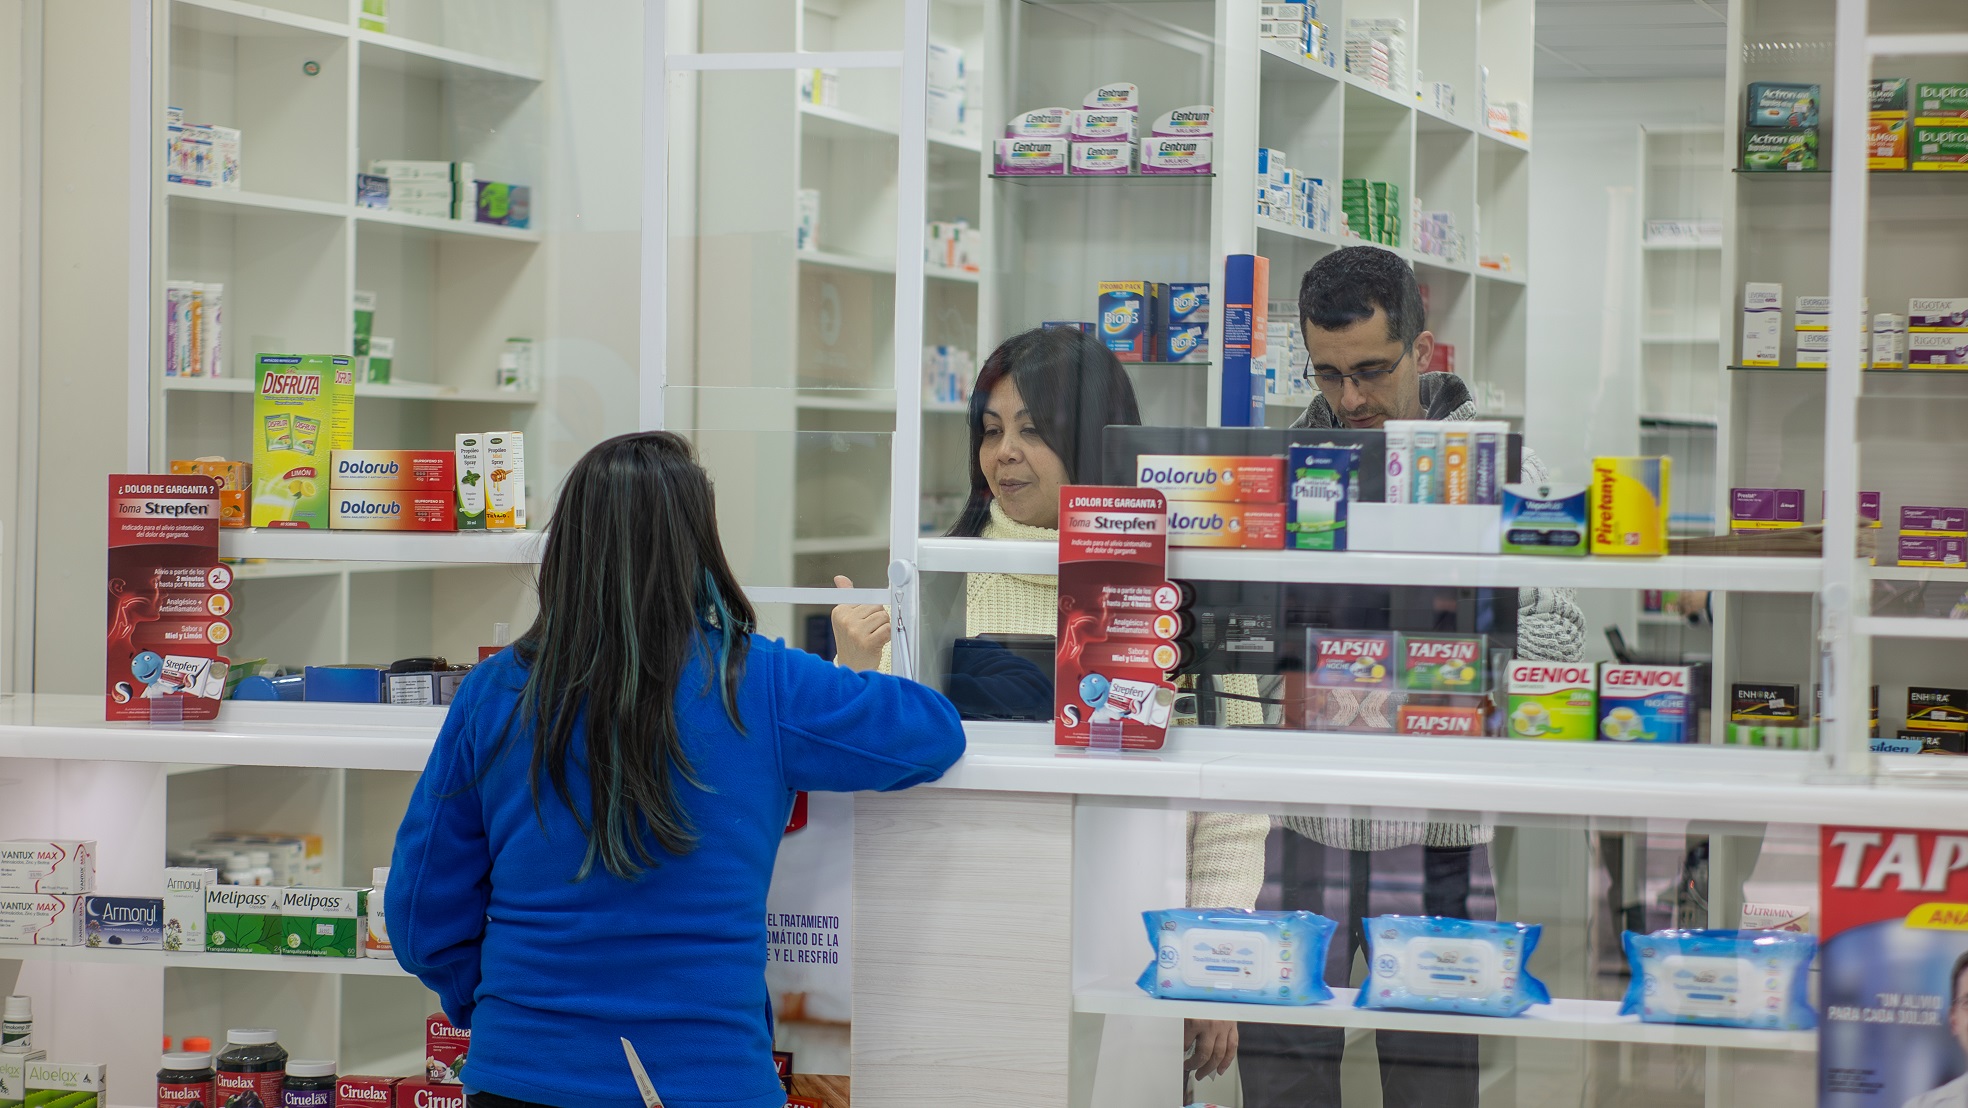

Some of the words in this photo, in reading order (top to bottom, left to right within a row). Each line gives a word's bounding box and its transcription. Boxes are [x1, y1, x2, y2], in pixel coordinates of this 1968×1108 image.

[1098, 89, 1130, 97] Centrum
[1762, 89, 1796, 99] Actron
[1026, 114, 1062, 123] Centrum
[1086, 115, 1118, 123] Centrum
[1171, 111, 1210, 121] Centrum
[1748, 134, 1788, 144] Actron
[1012, 142, 1052, 151] Centrum
[1160, 142, 1197, 151] Centrum
[1913, 301, 1951, 309] RIGOTAX
[1914, 336, 1952, 345] RIGOTAX
[262, 373, 320, 395] DISFRUTA
[291, 468, 311, 477] LIMÓN
[339, 461, 399, 474] Dolorub
[1141, 468, 1217, 484] Dolorub
[125, 485, 152, 494] DOLOR
[153, 485, 164, 494] DE
[166, 485, 208, 494] GARGANTA
[210, 486, 214, 494] ?
[1295, 485, 1340, 501] Phillips
[119, 504, 141, 513] Toma
[145, 502, 208, 517] Strepfen
[340, 500, 401, 514] Dolorub
[1075, 498, 1100, 507] DOLOR
[1103, 498, 1113, 507] DE
[1114, 499, 1156, 508] GARGANTA
[1157, 500, 1162, 508] ?
[1596, 468, 1617, 545] Piretanyl
[1069, 517, 1090, 527] Toma
[1094, 516, 1156, 531] Strepfen
[1168, 512, 1224, 530] lorub
[1114, 619, 1143, 627] Analgésico
[1320, 640, 1385, 656] TAPSIN
[1409, 643, 1475, 658] TAPSIN
[165, 660, 198, 672] Strepfen
[1513, 667, 1591, 683] GENIOL
[1605, 670, 1684, 687] GENIOL
[1112, 683, 1144, 698] Strepfen
[1644, 699, 1684, 708] NOCHE
[1406, 716, 1472, 731] TAPSIN
[1869, 742, 1909, 753] silden
[1, 851, 33, 859] VANTUX
[37, 851, 58, 860] MAX
[1829, 831, 1968, 892] TAP
[167, 878, 201, 892] Armonyl
[0, 902, 33, 910] VANTUX
[36, 903, 57, 911] MAX
[208, 891, 267, 908] Melipass
[283, 893, 340, 910] Melipass
[102, 902, 156, 926] Armonyl
[1743, 904, 1793, 918] ULTRIMIN
[768, 913, 778, 926] EL
[779, 914, 839, 929] TRATAMIENTO
[812, 933, 823, 946] DE
[827, 934, 839, 947] LA
[774, 949, 780, 961] Y
[784, 949, 795, 962] EL
[798, 949, 838, 964] RESFRÍO
[1161, 951, 1174, 960] 80
[1, 1064, 20, 1074] elax
[30, 1067, 77, 1082] Aloelax
[217, 1074, 254, 1088] Ciruelax
[159, 1087, 200, 1100] Ciruelax
[285, 1092, 327, 1105] Ciruelax
[340, 1084, 388, 1100] Ciruelax
